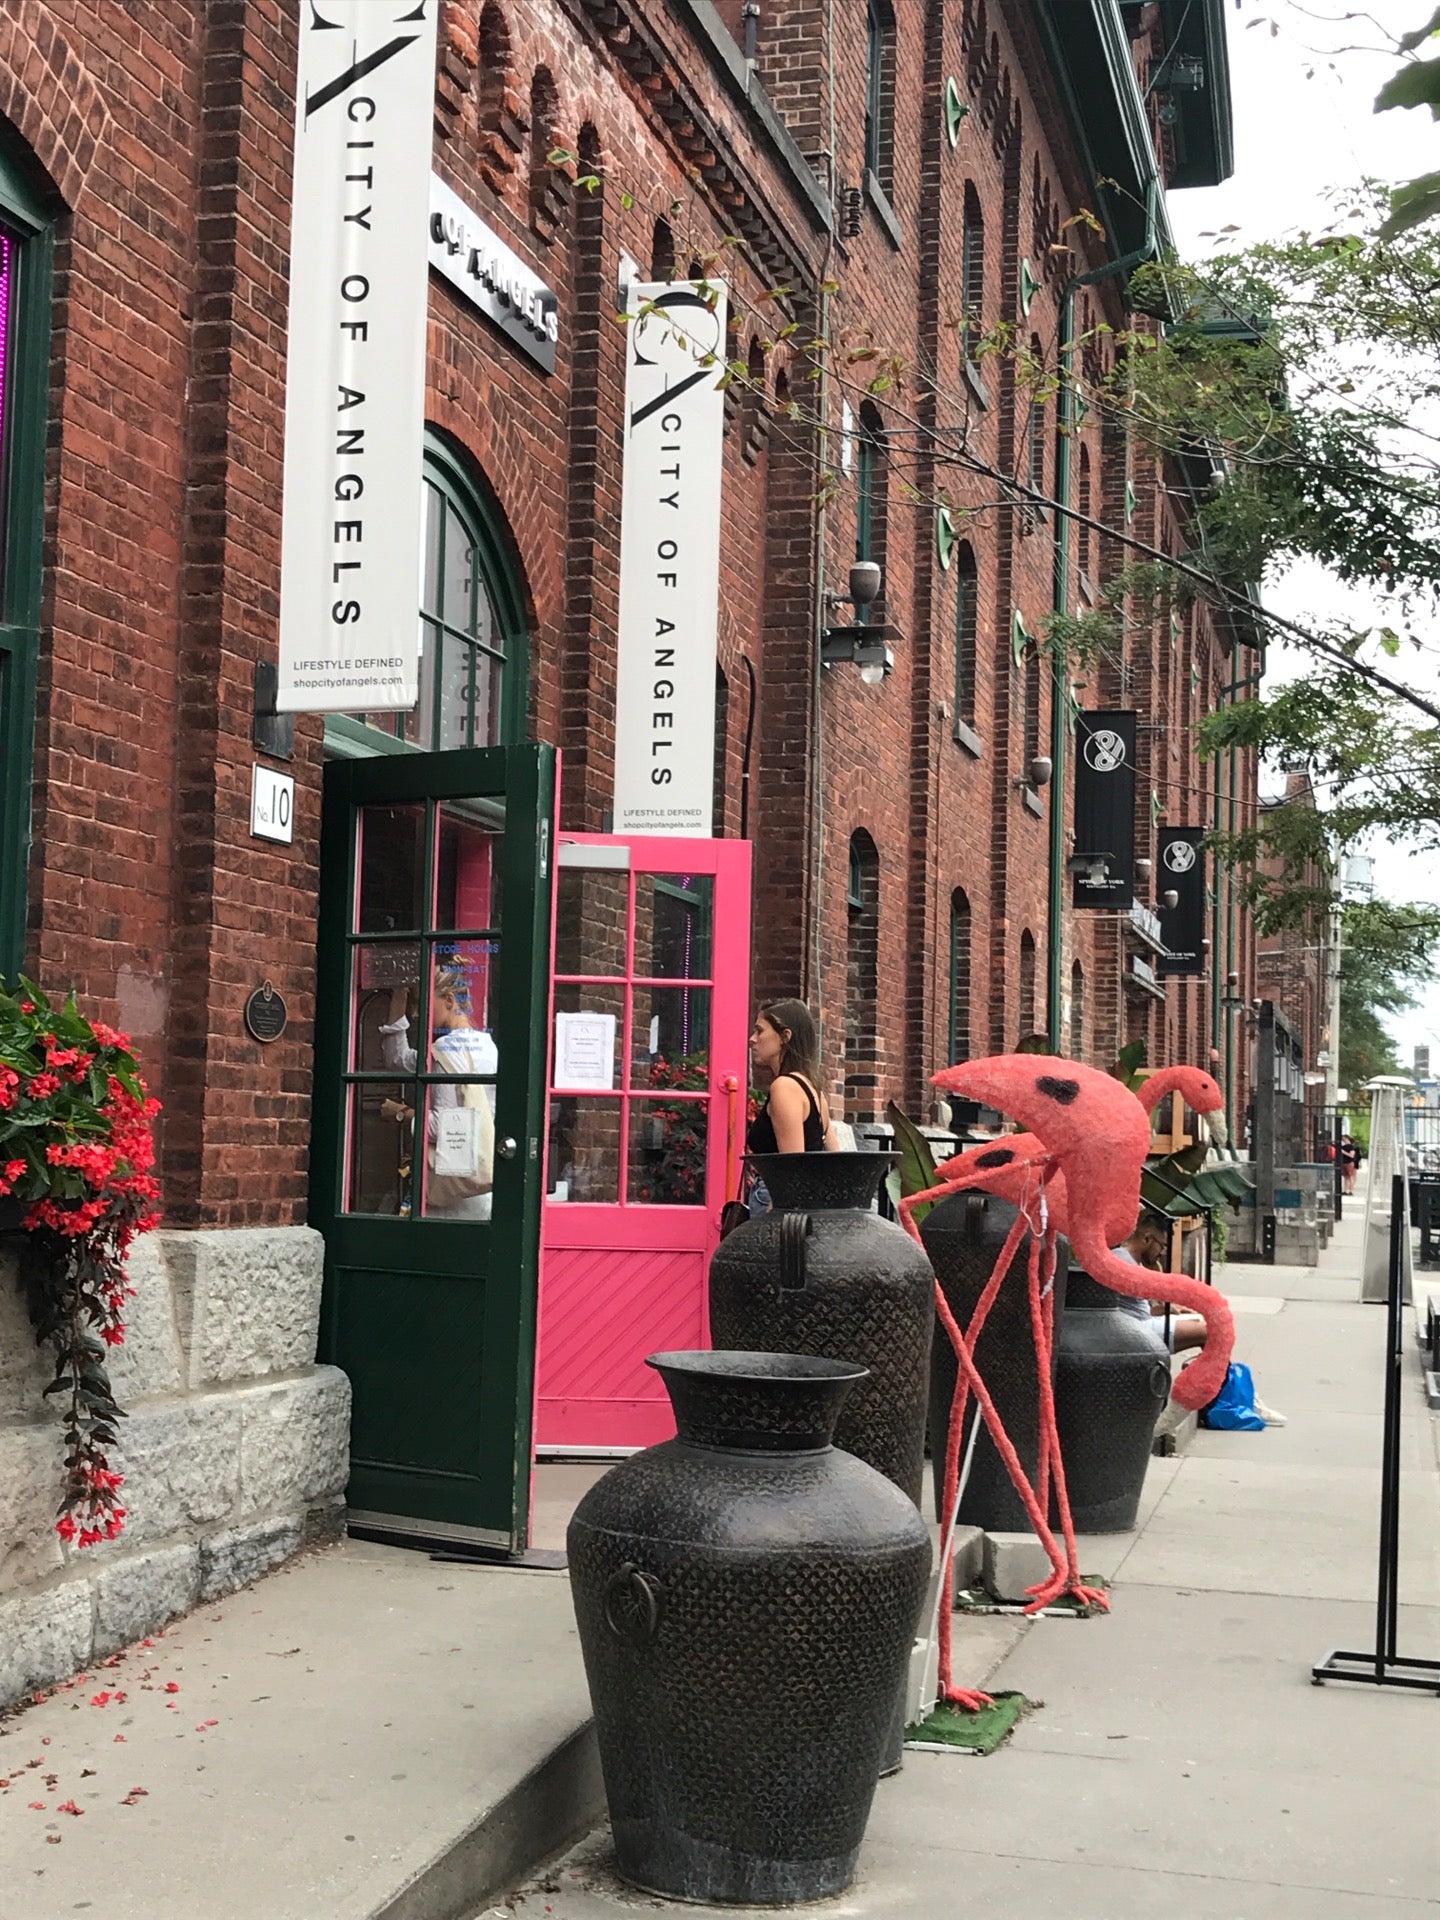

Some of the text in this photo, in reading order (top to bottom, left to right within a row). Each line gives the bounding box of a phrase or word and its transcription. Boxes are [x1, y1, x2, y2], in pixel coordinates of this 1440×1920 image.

[331, 96, 376, 625] CITY OF ANGELS
[651, 413, 682, 786] CITY OF ANGELS
[293, 657, 403, 671] LIFESTYLE DEFINED
[293, 676, 403, 689] shopcityofangels.com
[271, 784, 290, 828] 10
[623, 808, 703, 817] LIFESTYLE DEFINED
[623, 821, 703, 830] shopcityofangels.com
